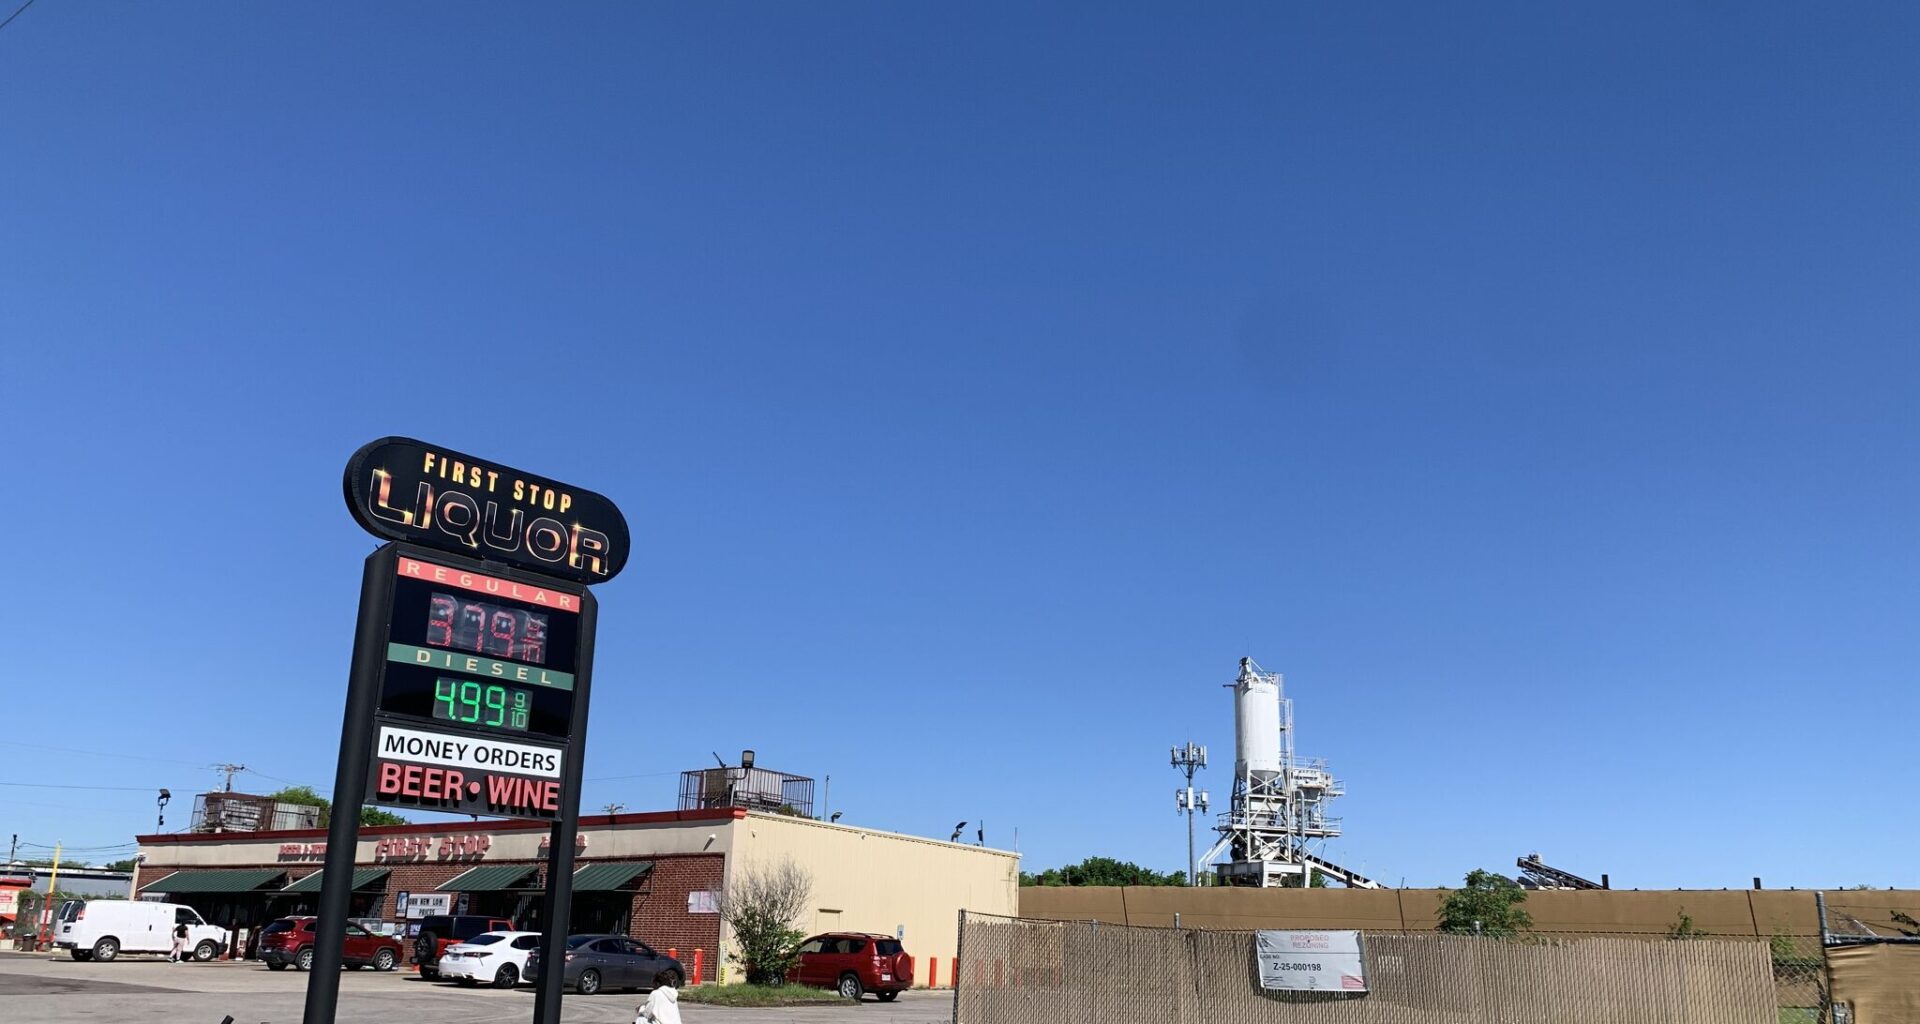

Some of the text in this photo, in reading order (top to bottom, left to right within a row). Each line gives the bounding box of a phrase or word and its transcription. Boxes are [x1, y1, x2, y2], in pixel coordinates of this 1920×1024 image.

[423, 452, 572, 513] FIRST STOP
[368, 467, 610, 576] LIQUOR
[406, 560, 572, 608] REGULAR
[416, 649, 553, 685] DIESEL
[434, 679, 507, 727] 4.99
[384, 734, 556, 772] MONEY ORDERS
[379, 762, 561, 811] BEER WINE
[375, 836, 492, 857] FIRST STOP
[1273, 962, 1322, 972] Z-25-000198
